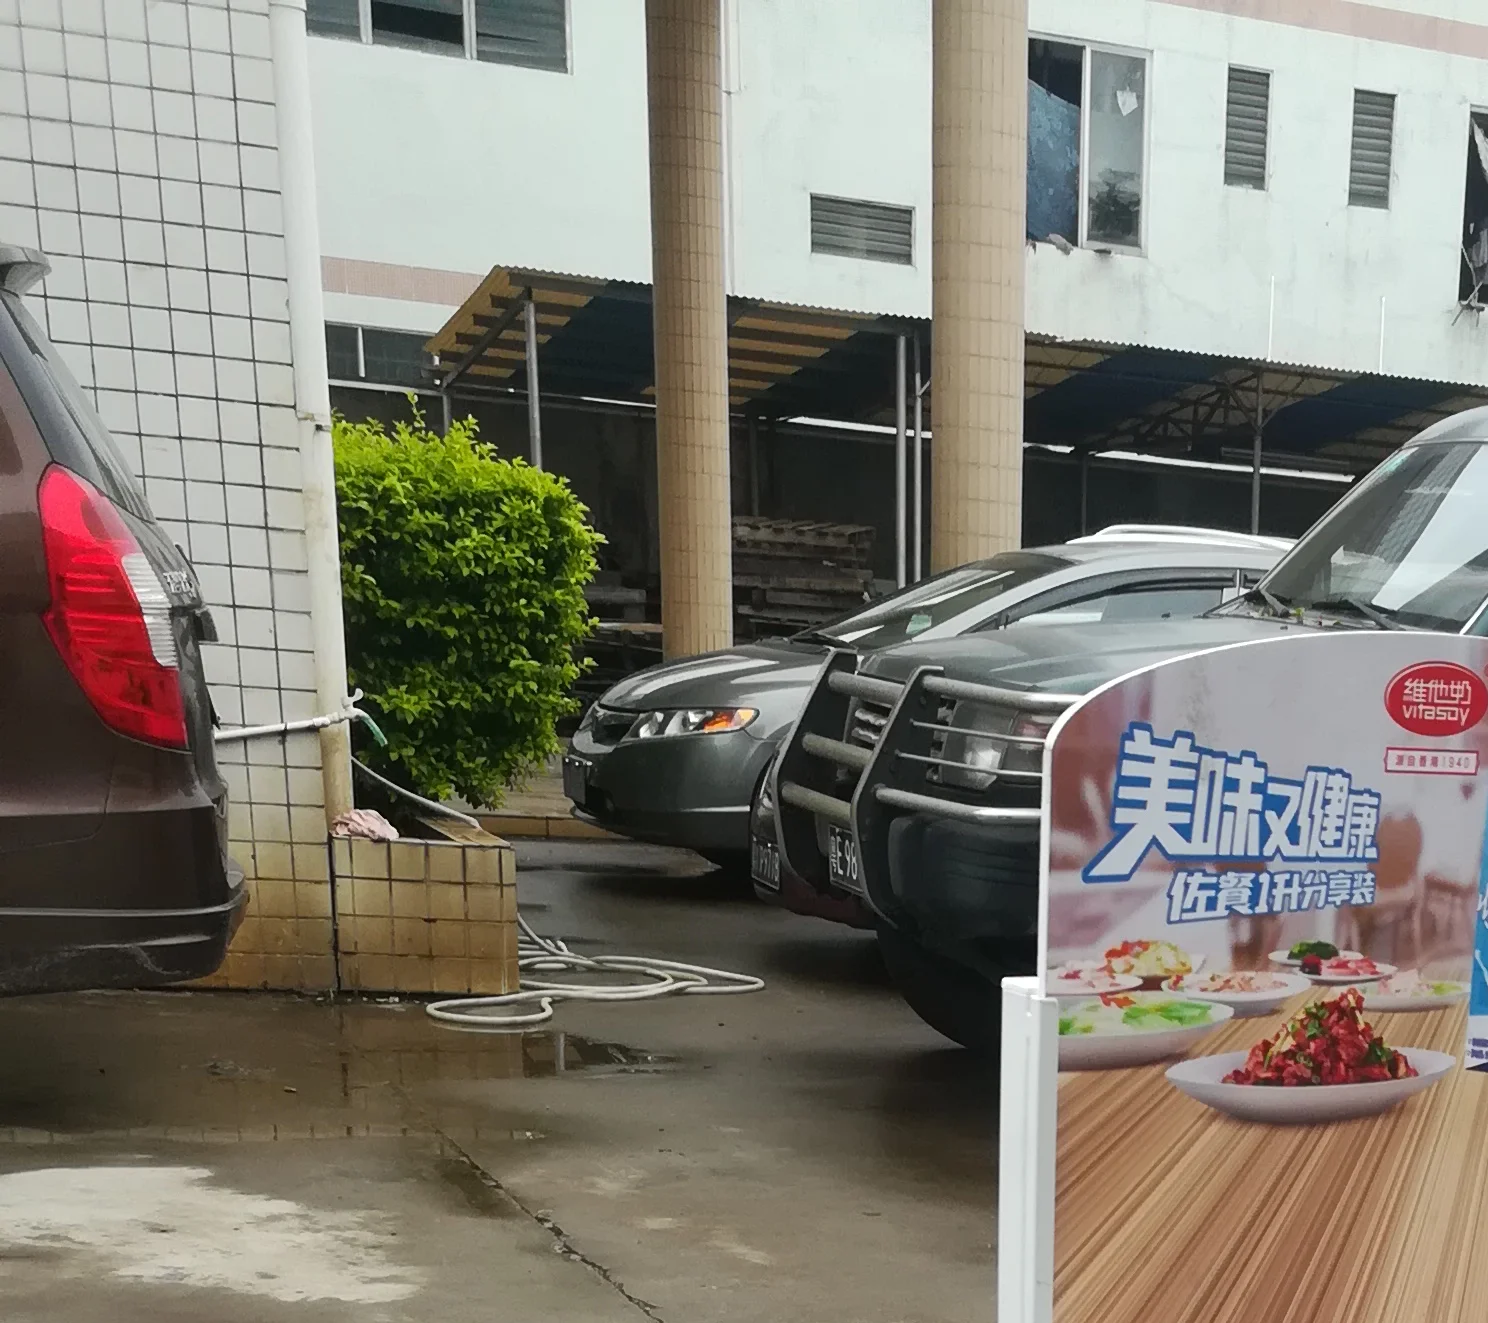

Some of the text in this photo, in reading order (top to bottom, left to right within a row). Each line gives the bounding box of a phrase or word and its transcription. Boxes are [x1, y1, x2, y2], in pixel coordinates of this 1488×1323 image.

[1083, 723, 1380, 882] 美味又健康
[1167, 868, 1376, 924] 佐餐1升分享装
